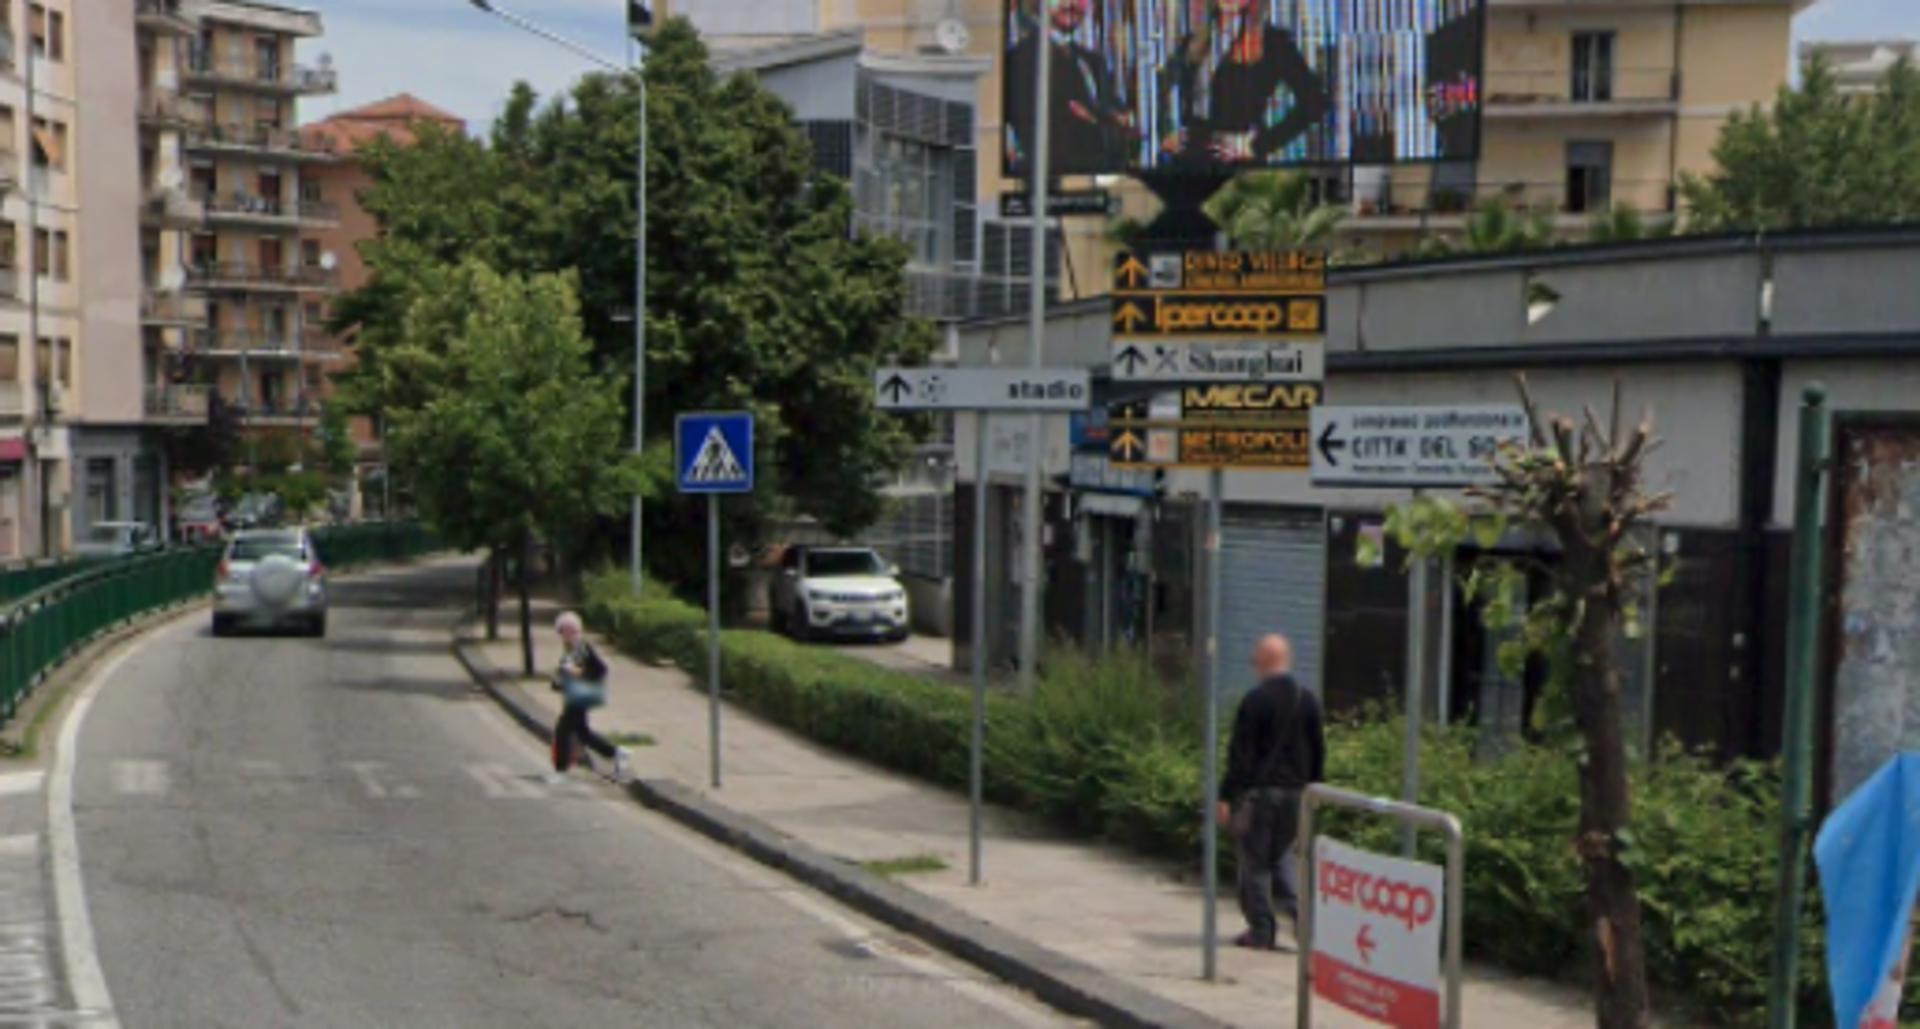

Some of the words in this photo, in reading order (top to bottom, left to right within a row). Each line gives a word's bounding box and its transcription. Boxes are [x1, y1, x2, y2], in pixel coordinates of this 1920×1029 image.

[1187, 350, 1302, 377] Shanghai
[1008, 380, 1083, 399] stadio
[1184, 385, 1319, 408] MECAR
[1182, 432, 1309, 449] METROPOLI
[1420, 436, 1457, 458] DEL
